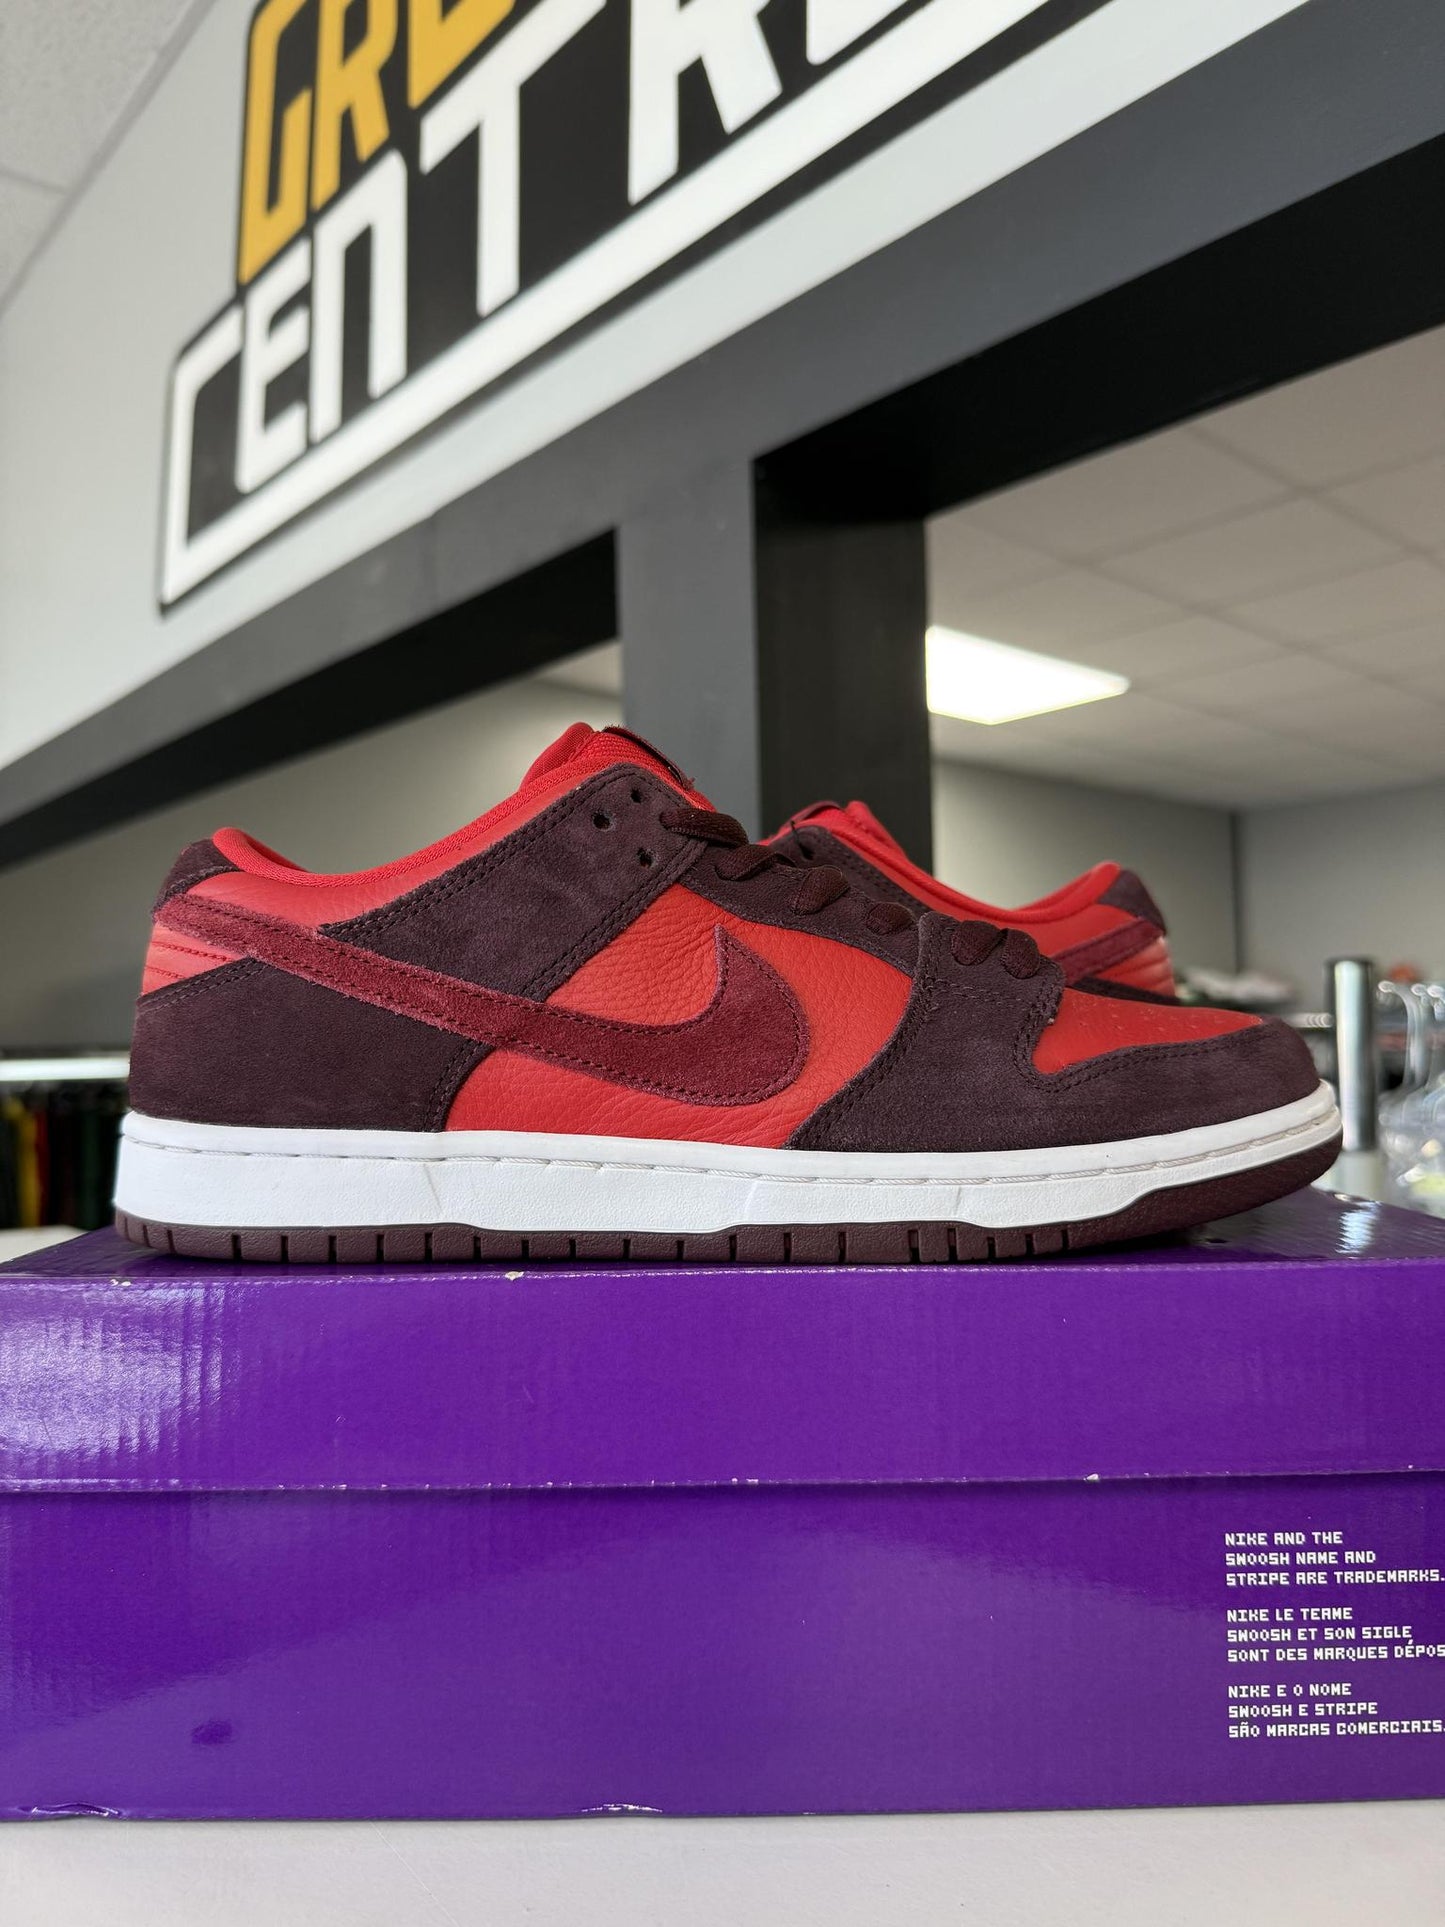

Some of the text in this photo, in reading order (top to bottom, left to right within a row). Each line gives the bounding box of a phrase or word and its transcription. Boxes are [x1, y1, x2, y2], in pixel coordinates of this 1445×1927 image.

[1224, 1531, 1343, 1546] NIKE AND THE
[1225, 1550, 1376, 1566] SWOOSH NAME AND
[1226, 1569, 1445, 1587] STRIPE ARE TRADEMARKS.
[1226, 1608, 1270, 1623] NIKE
[1275, 1608, 1294, 1622] LE
[1227, 1625, 1412, 1643] SWOOSH ET SON SIGLE
[1227, 1648, 1270, 1663] SONT
[1275, 1647, 1308, 1662] DES
[1313, 1646, 1388, 1662] MARQUES
[1228, 1682, 1352, 1699] NIKE E O NOME
[1228, 1701, 1378, 1719] SWOOSH E STRIPE
[1228, 1721, 1261, 1738] SÃO
[1266, 1723, 1331, 1737] MARCAS
